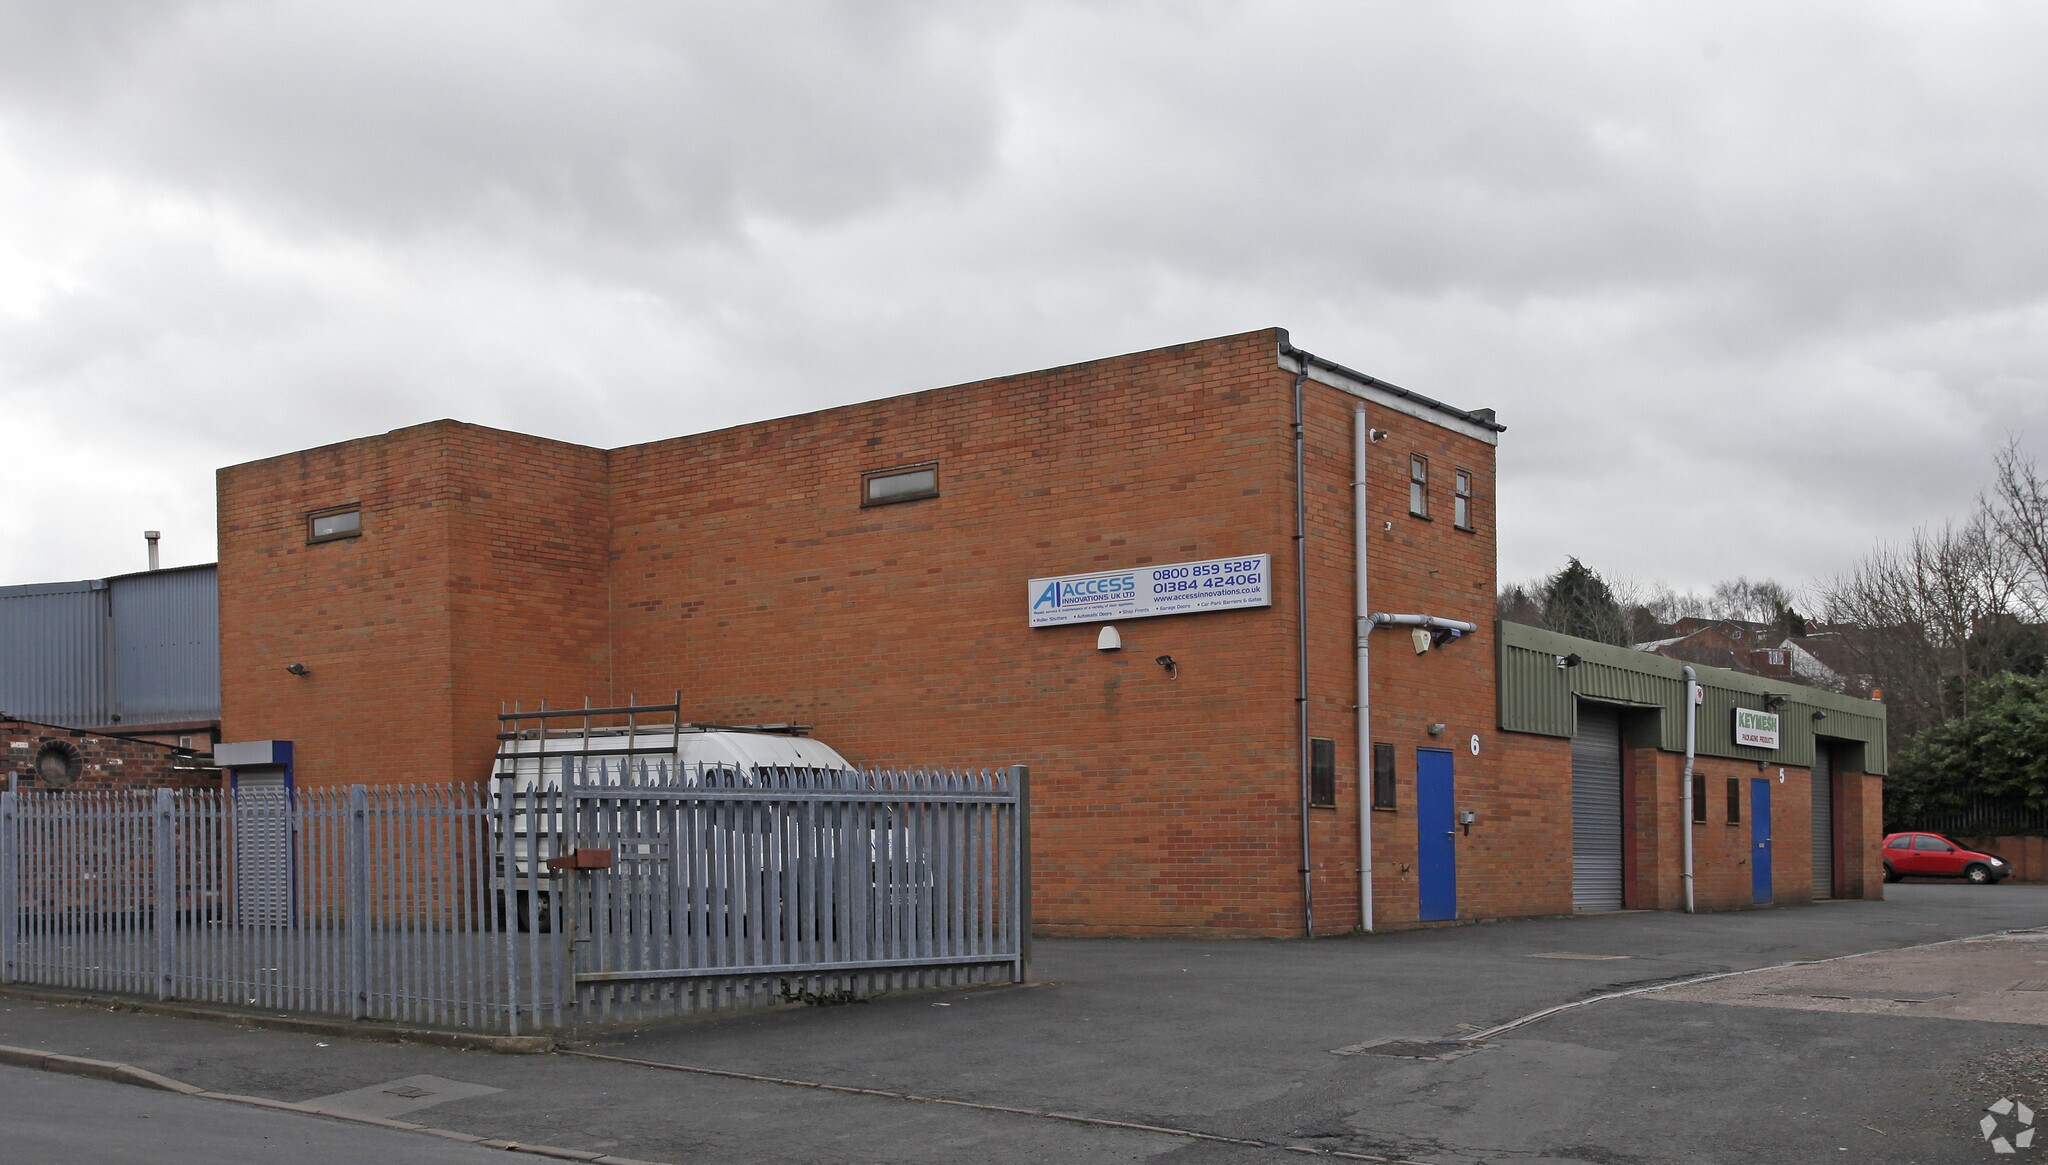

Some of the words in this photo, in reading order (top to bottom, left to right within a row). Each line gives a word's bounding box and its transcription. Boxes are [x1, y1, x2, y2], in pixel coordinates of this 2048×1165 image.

[1153, 567, 1189, 581] 0800
[1192, 564, 1220, 577] 859
[1224, 560, 1261, 573] 5287
[1062, 576, 1135, 597] ACCESS
[1153, 580, 1198, 593] 01384
[1203, 573, 1261, 588] 424061
[1062, 593, 1109, 604] INNOVATIONS
[1110, 592, 1121, 600] UK
[1122, 591, 1135, 599] LTD
[1153, 586, 1261, 603] www.accessinnovations.co.uk
[1738, 712, 1777, 733] KEYMESH
[1470, 734, 1480, 756] 6
[1779, 767, 1785, 784] 5
